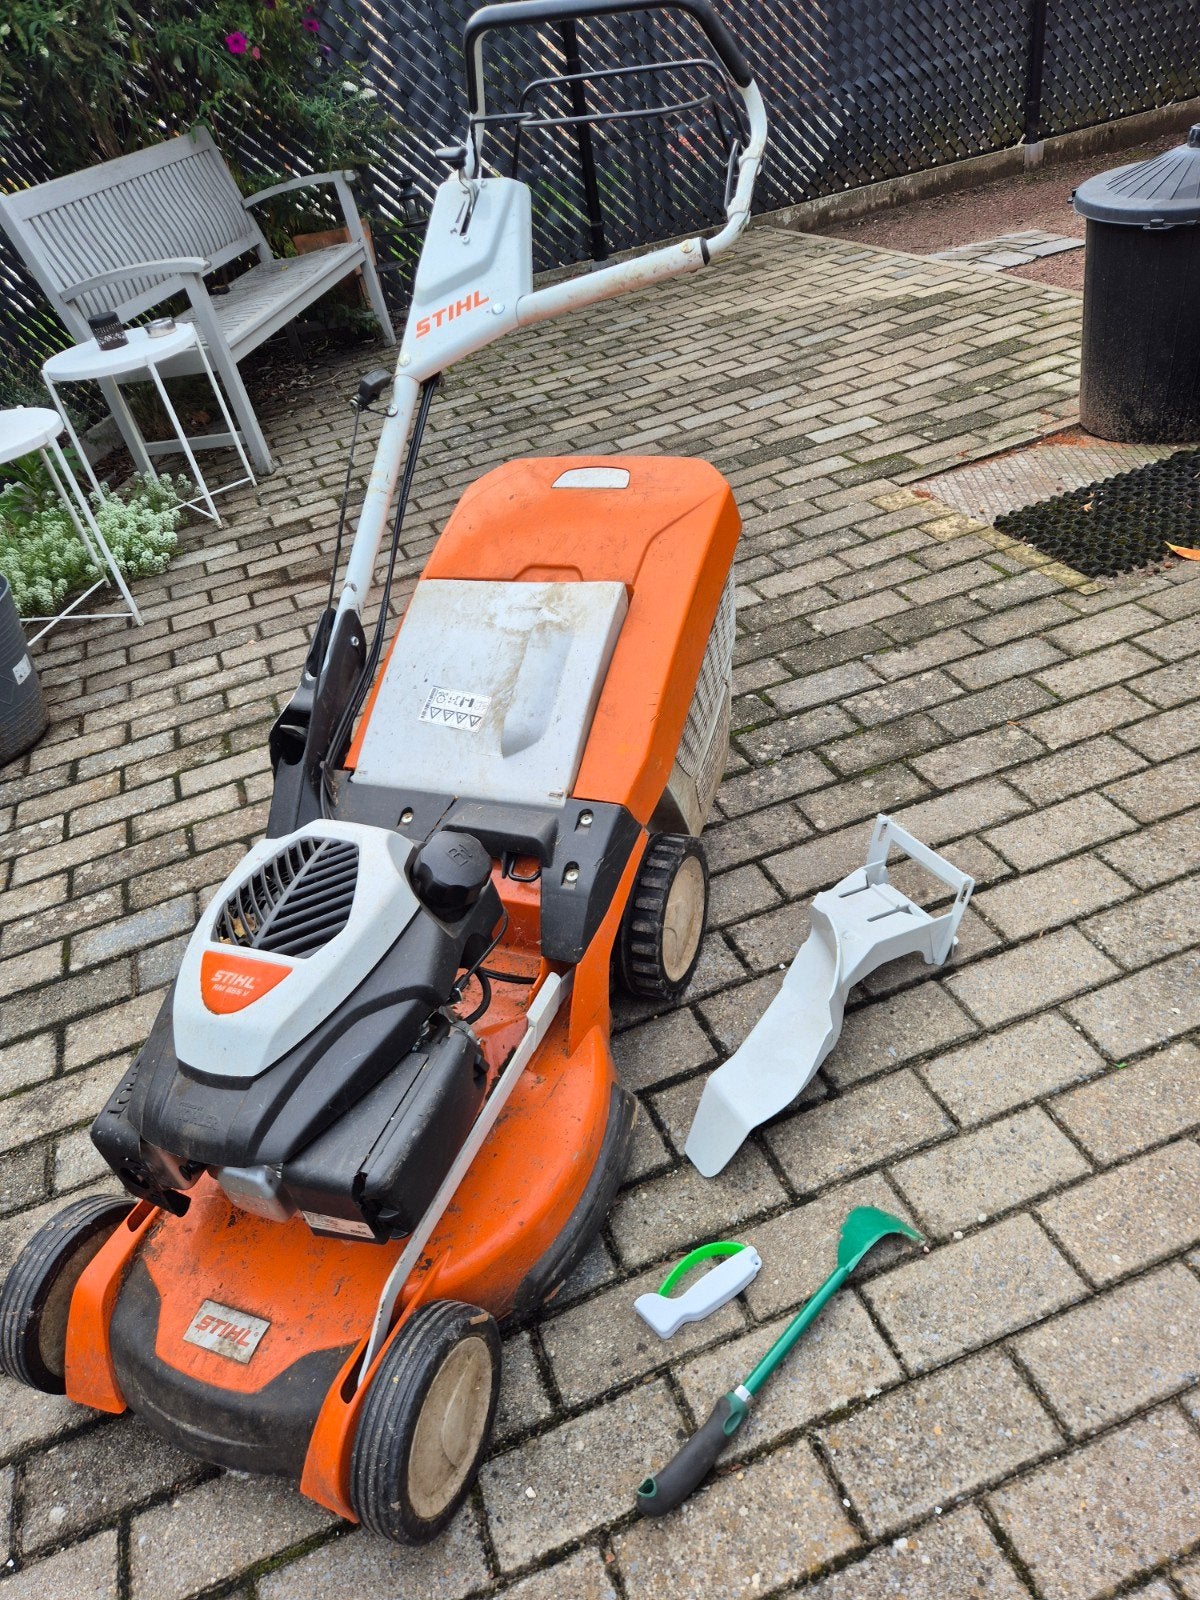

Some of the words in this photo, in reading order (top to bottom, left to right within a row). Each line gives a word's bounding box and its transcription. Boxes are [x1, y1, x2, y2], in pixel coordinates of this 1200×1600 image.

[415, 290, 490, 340] STIHL
[211, 969, 255, 990] STIHL
[194, 1314, 252, 1348] STIHL
